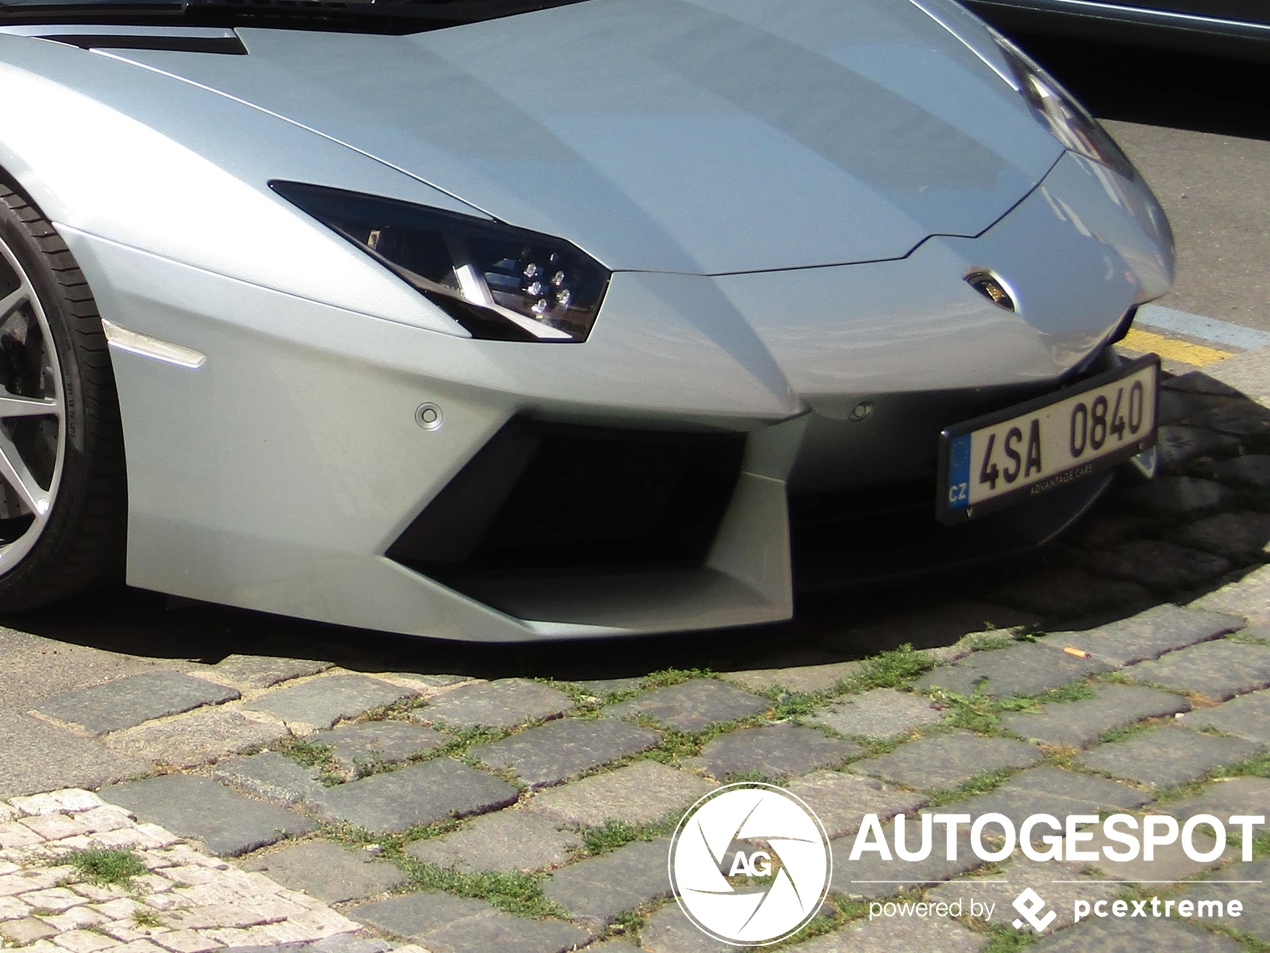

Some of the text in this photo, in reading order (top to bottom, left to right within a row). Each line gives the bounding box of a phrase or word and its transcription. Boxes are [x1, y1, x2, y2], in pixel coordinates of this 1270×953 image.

[979, 379, 1143, 490] 4SA 0840
[948, 482, 967, 503] CZ
